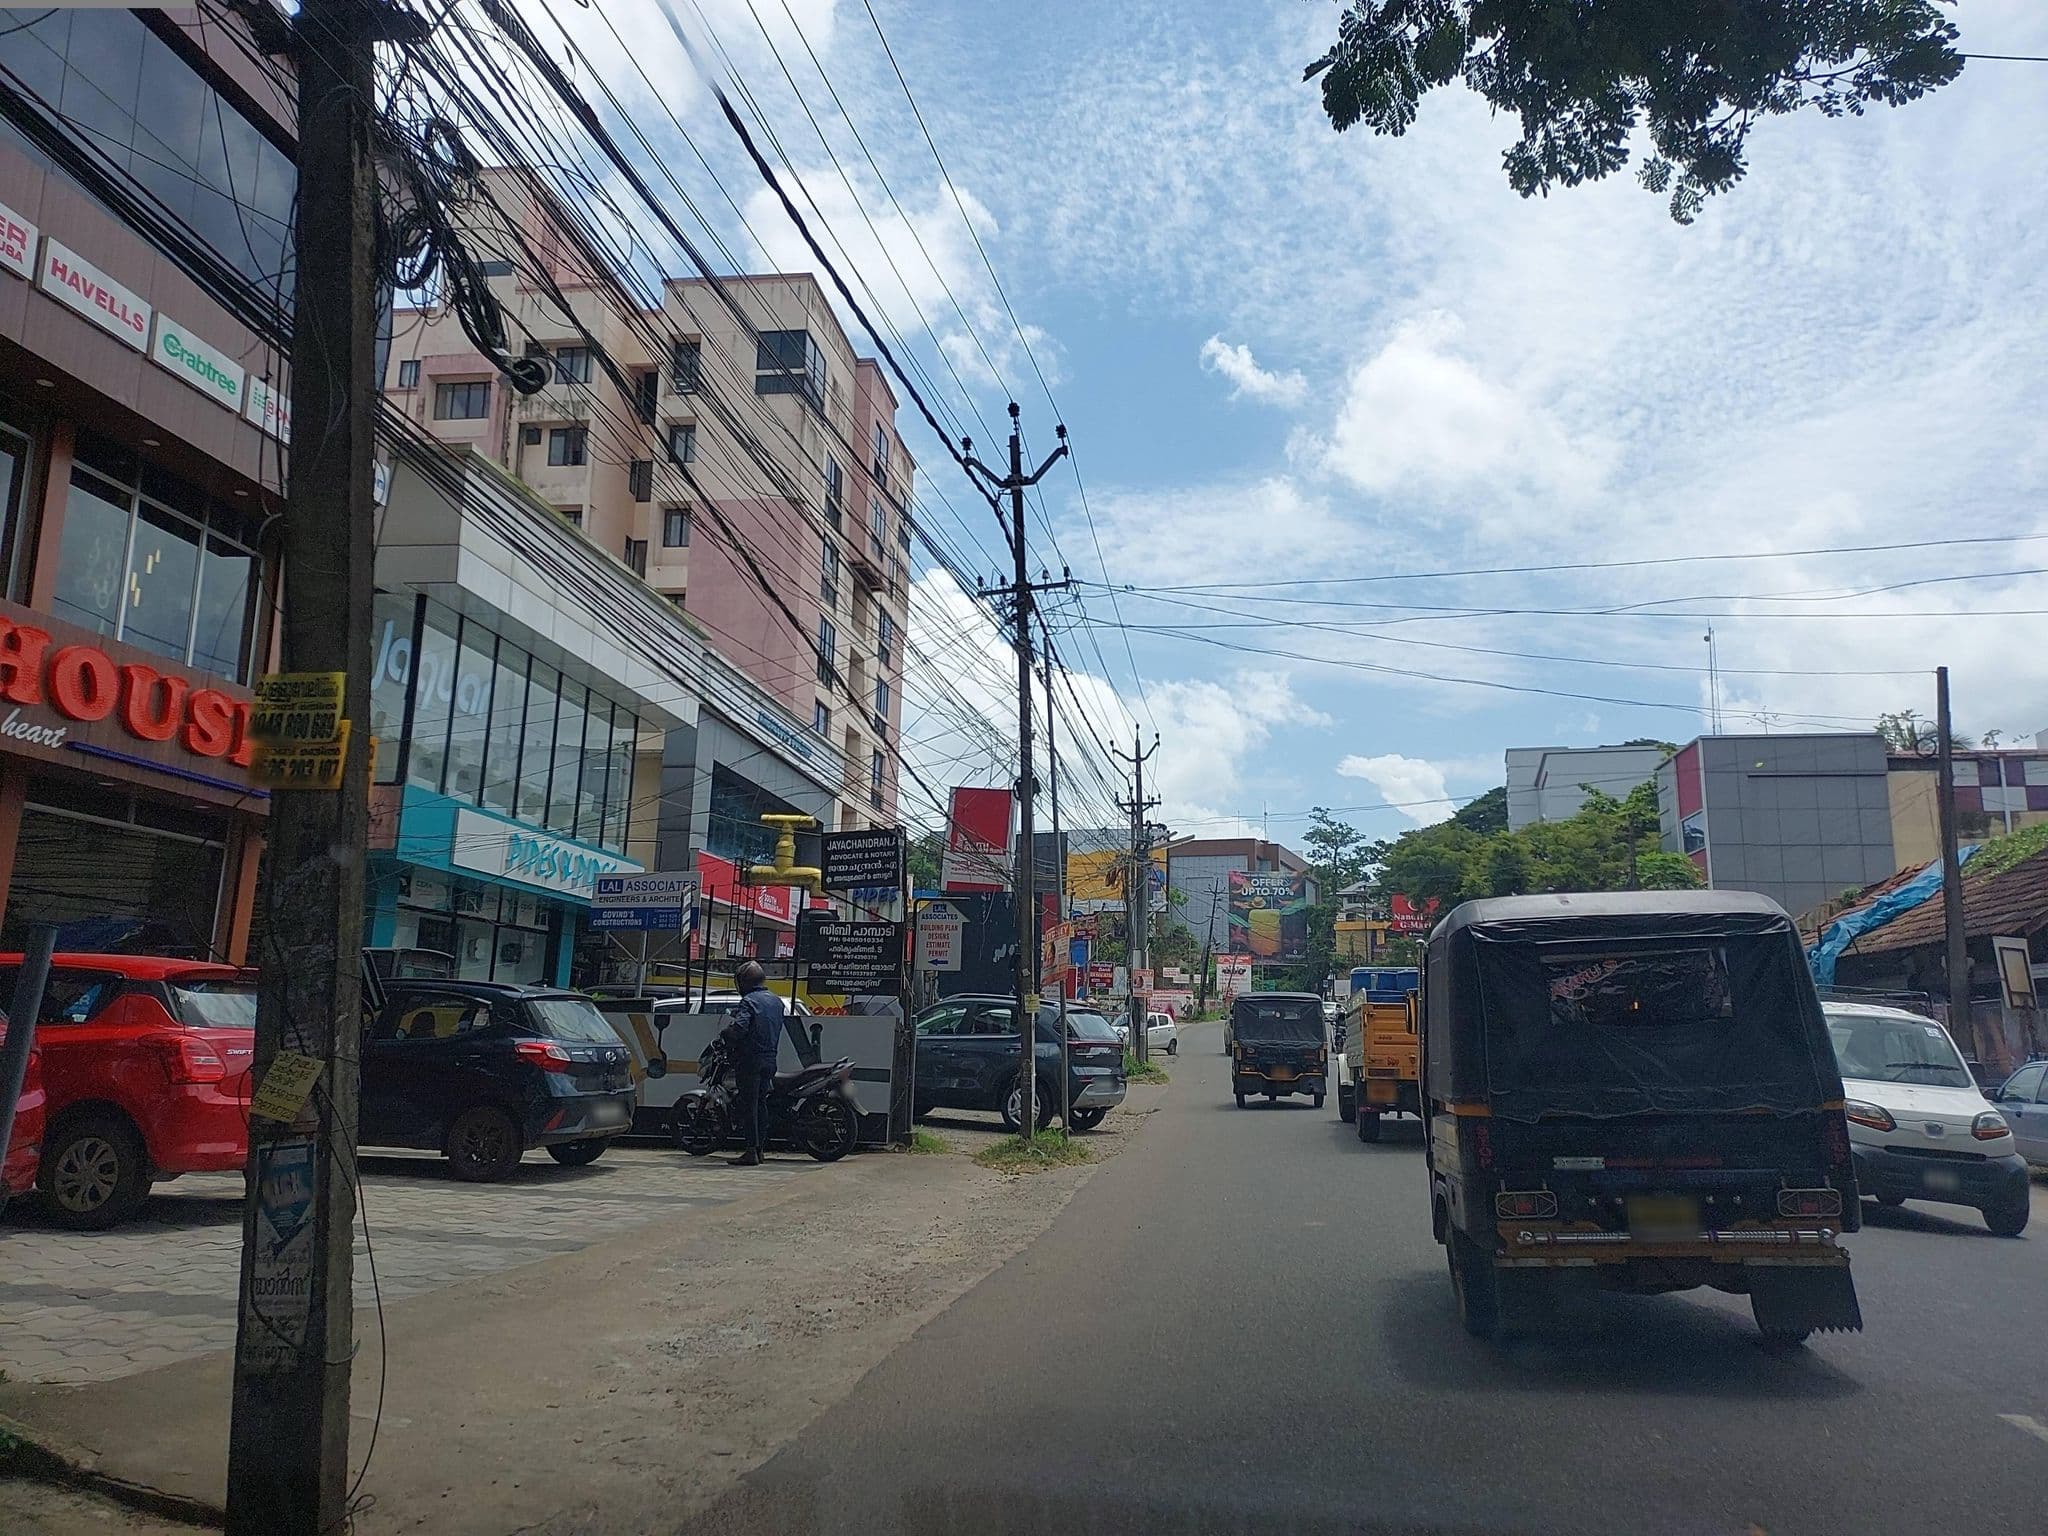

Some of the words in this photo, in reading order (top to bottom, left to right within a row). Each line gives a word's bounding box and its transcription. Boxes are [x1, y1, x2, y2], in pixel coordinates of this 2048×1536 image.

[51, 257, 144, 333] HAVELLS
[163, 334, 236, 395] Crabtree
[1, 708, 67, 749] heart
[830, 852, 864, 861] ADVOCATE
[870, 850, 895, 858] NOTARY
[601, 881, 622, 892] LAL
[1241, 887, 1270, 896] UPTO
[1273, 887, 1294, 896] 70%
[599, 895, 641, 904] ENGINEERS
[648, 895, 681, 903] ARCHITE
[603, 910, 634, 919] GOVIND'S
[593, 918, 642, 926] CONSTRUCTIONS
[928, 932, 950, 940] DESIGNS
[926, 941, 951, 949] ESTIMATE
[225, 1049, 254, 1057] SWIFT
